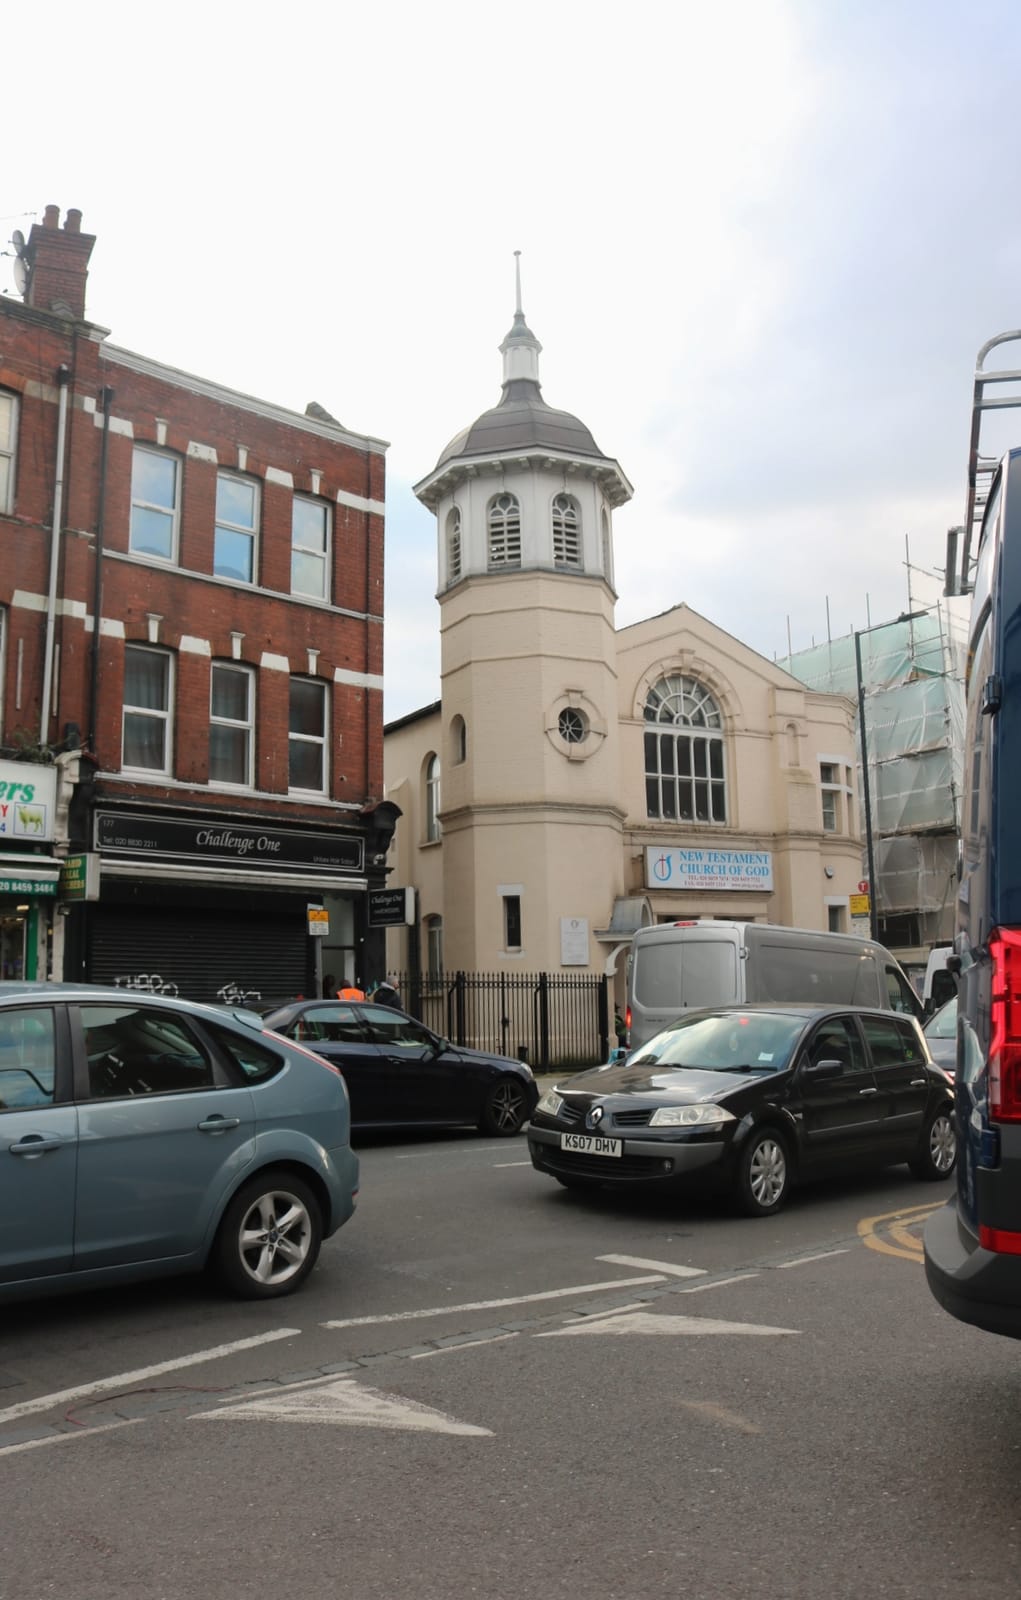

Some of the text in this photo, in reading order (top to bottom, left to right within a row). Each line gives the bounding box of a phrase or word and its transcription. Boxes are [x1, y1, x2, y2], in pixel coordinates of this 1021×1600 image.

[196, 829, 281, 855] Challenge One
[680, 851, 769, 864] NEW TESTAMENT
[680, 863, 769, 876] CHURCH OF GOD
[565, 1134, 617, 1153] KS07 DHV
